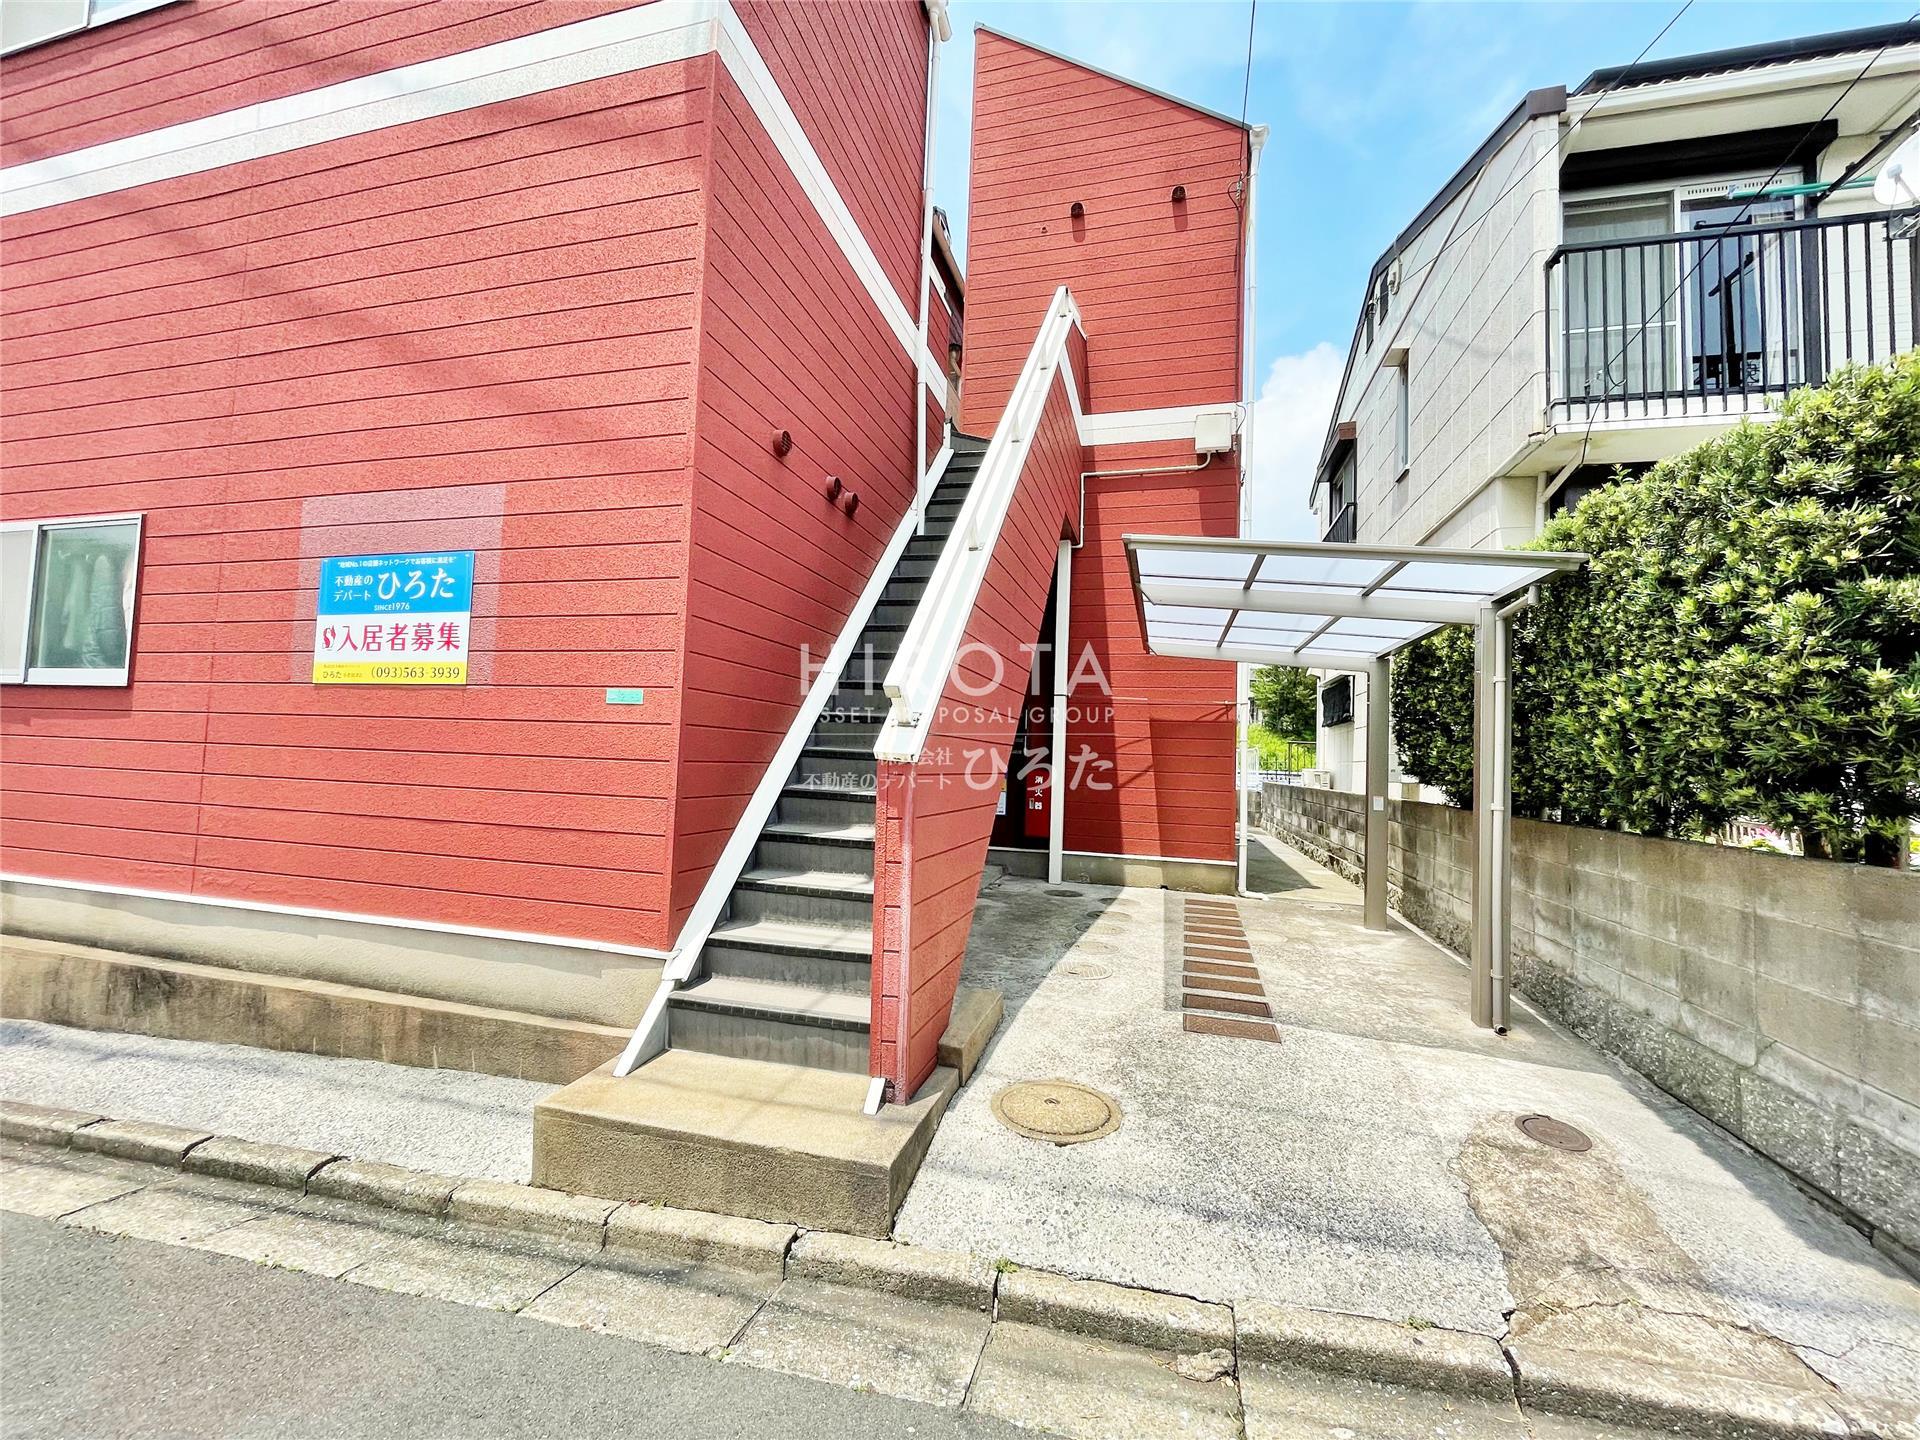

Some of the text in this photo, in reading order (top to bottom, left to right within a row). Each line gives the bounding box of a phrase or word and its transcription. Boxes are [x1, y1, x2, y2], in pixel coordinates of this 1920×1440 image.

[334, 575, 373, 587] 不動産の
[378, 567, 456, 600] ひろた
[333, 589, 372, 601] デパート
[337, 622, 461, 652] 入居者募集
[322, 671, 342, 679] ひろた
[371, 666, 460, 679] (093)563-3939
